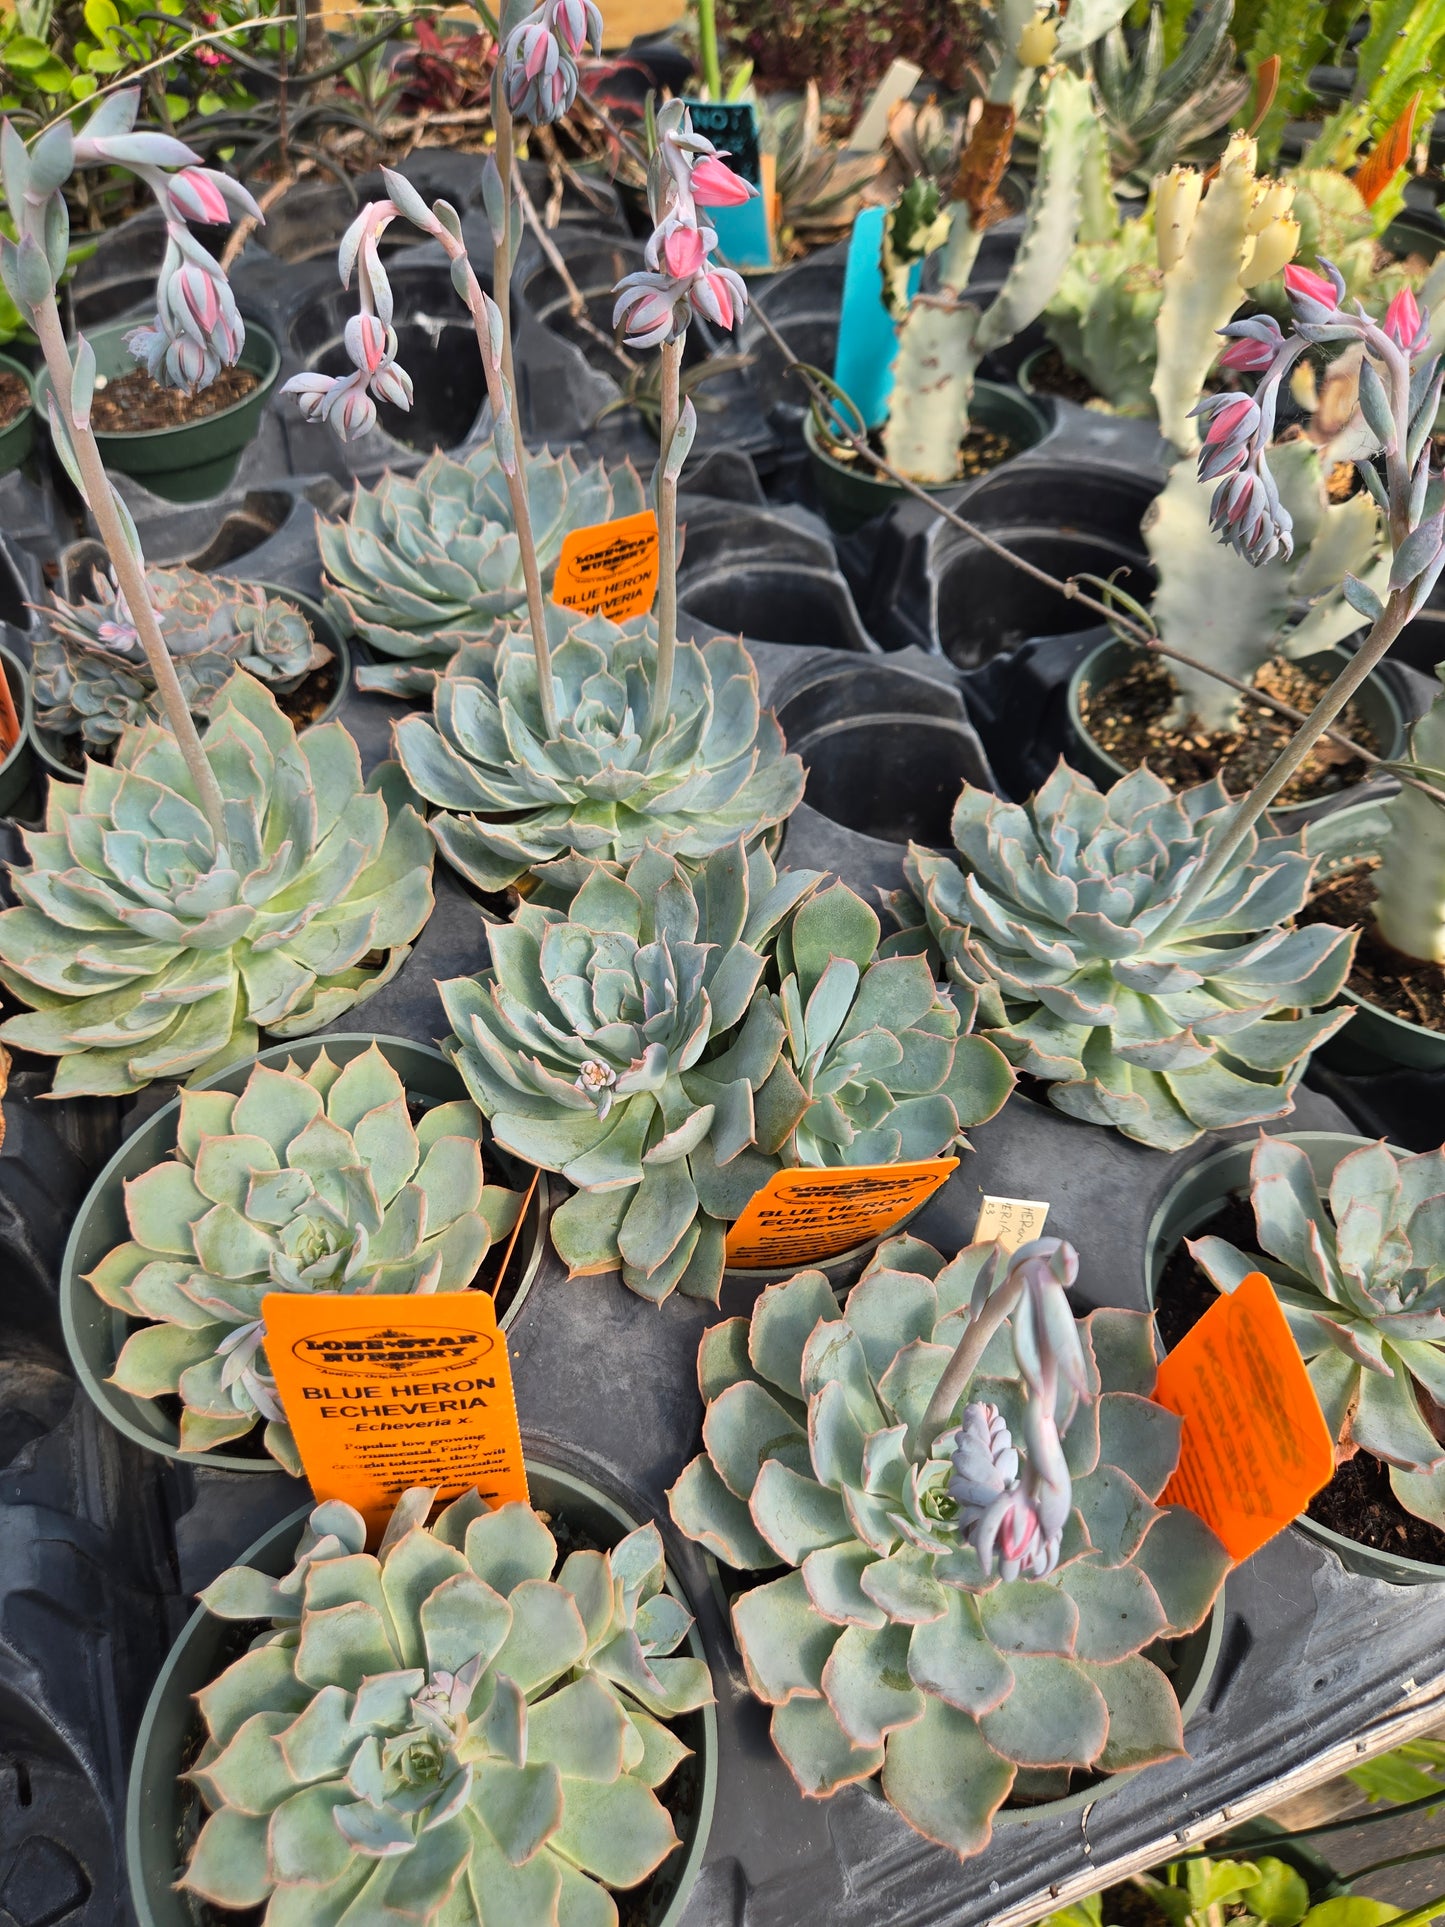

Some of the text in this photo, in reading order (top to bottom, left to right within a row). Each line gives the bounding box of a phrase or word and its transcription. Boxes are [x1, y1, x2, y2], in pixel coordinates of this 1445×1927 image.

[563, 571, 653, 606] BLUE HERON
[757, 1207, 822, 1219] BLUE
[829, 1196, 915, 1214] HERON
[760, 1206, 895, 1227] ECHEVERIA
[302, 1377, 497, 1400] BLUE HERON
[321, 1396, 487, 1419] ECHEVERIA
[344, 1442, 398, 1451] Popular
[430, 1434, 486, 1446] growing
[441, 1444, 480, 1453] Fairly
[450, 1453, 479, 1461] they
[482, 1448, 506, 1457] will
[392, 1468, 426, 1476] more
[430, 1459, 504, 1473] spectacular
[454, 1466, 511, 1478] watering
